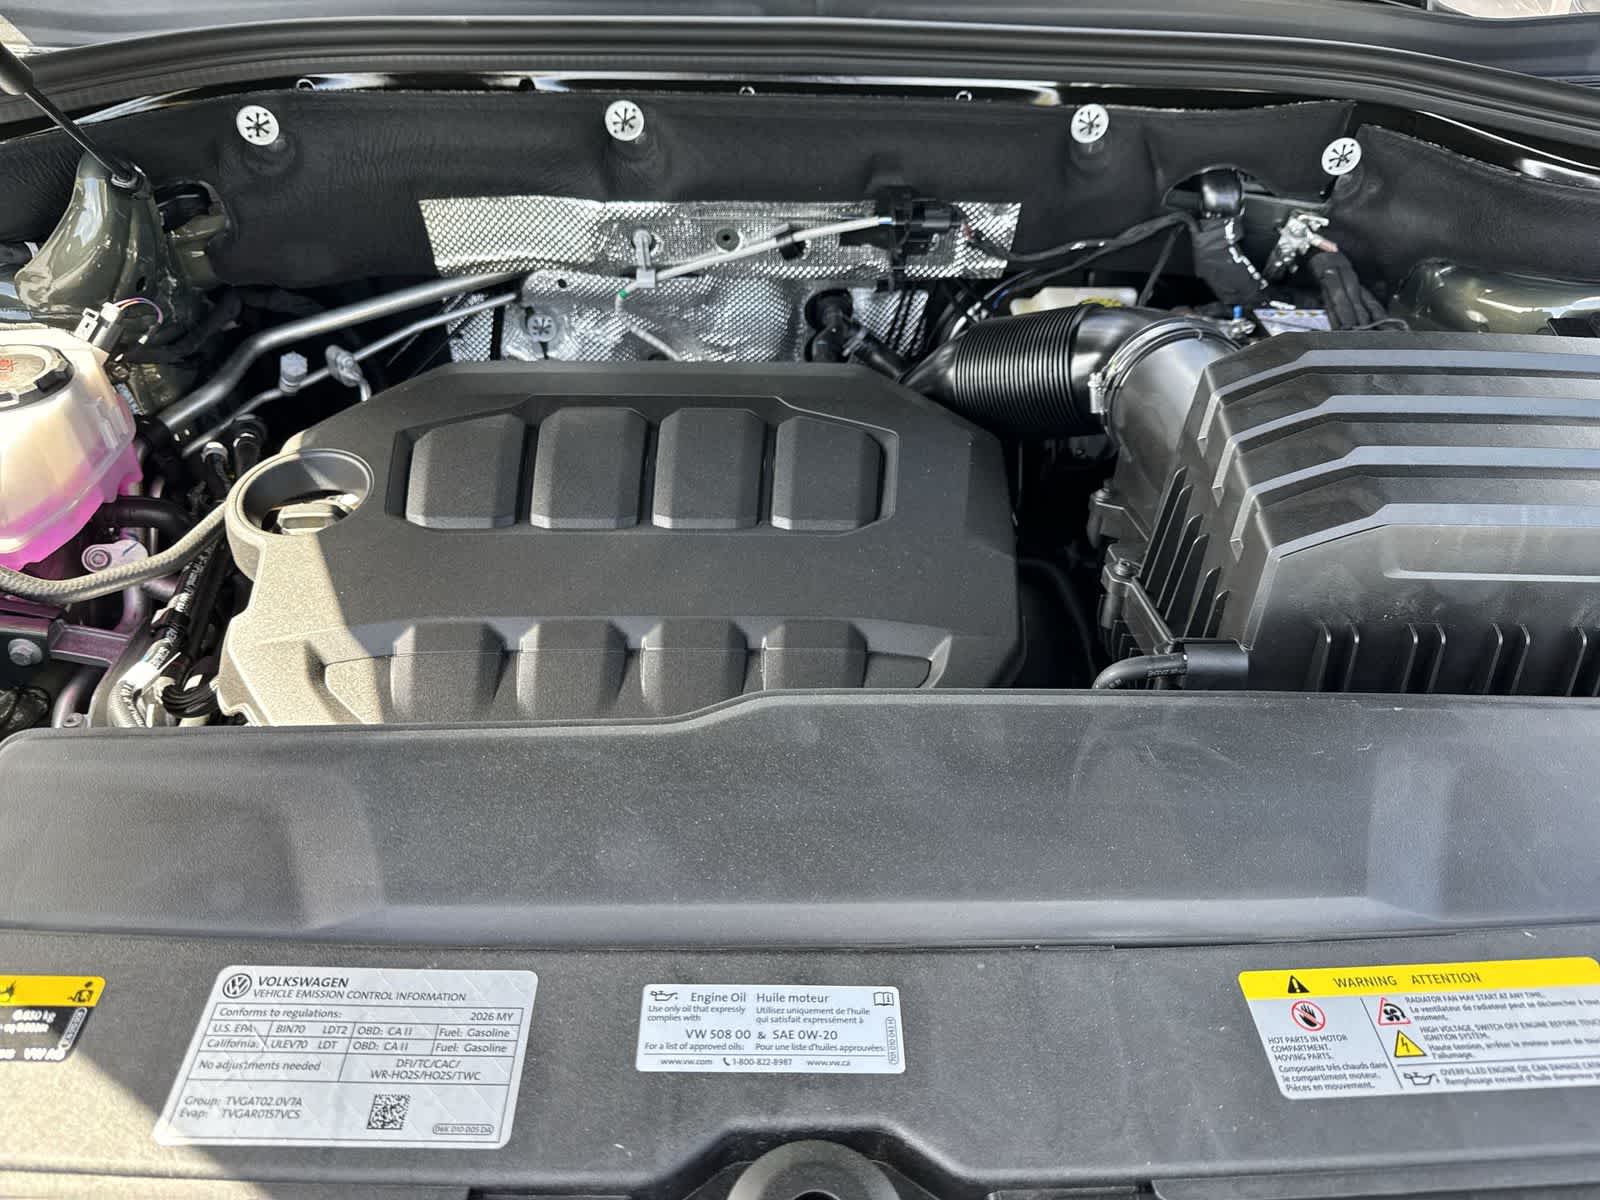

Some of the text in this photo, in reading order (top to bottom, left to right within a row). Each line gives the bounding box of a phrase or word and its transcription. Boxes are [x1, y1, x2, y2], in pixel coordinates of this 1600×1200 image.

[258, 976, 349, 988] VOLKSWAGEN
[1332, 972, 1482, 988] WARNING ATTENTION
[253, 989, 466, 1001] VEHICLE EMISSION CONTROL INFORMATION
[691, 992, 746, 1004] Engine Oil
[756, 992, 829, 1003] Huile moteur
[219, 1007, 342, 1019] Conforms to regulations:
[648, 1005, 745, 1015] Use only oil that expressly
[756, 1007, 785, 1015] Utilisez
[786, 1007, 834, 1017] uniquement
[835, 1007, 846, 1015] de
[470, 1012, 514, 1021] 2026 MY
[647, 1015, 681, 1023] complies
[756, 1016, 769, 1024] qui
[802, 1016, 857, 1025] expressément
[213, 1024, 232, 1033] U.S.
[276, 1025, 306, 1034] BIN70
[322, 1025, 348, 1035] LDT2
[357, 1026, 383, 1036] OBD:
[438, 1028, 463, 1037] Fuel:
[466, 1028, 511, 1038] Gasoline
[686, 1029, 838, 1040] VW 508 00 & SAE 0W-20
[1268, 1036, 1284, 1044] HOT
[1285, 1035, 1309, 1043] PARTS
[1319, 1034, 1348, 1042] MOTOR
[271, 1039, 309, 1049] ULEV70
[317, 1040, 338, 1049] LDT
[352, 1041, 379, 1051] OBD:
[435, 1042, 459, 1052] Fuel:
[463, 1043, 508, 1053] Gasoline
[644, 1042, 657, 1050] For
[666, 1042, 678, 1050] list
[679, 1042, 688, 1050] of
[689, 1042, 727, 1051] approved
[755, 1043, 774, 1051] Pour
[791, 1043, 807, 1051] liste
[1271, 1043, 1332, 1053] COMPARTMENT.
[660, 1058, 713, 1066] www.vw.com
[1274, 1053, 1307, 1061] MOVING
[198, 1060, 321, 1072] No adjustments needed
[396, 1059, 461, 1069] DFI/TC/CAC/
[1278, 1064, 1325, 1073] Composants
[1342, 1062, 1370, 1070] chauds
[1369, 1061, 1388, 1069] dans
[1291, 1073, 1348, 1082] compartiment
[184, 1096, 221, 1107] Group:
[179, 1109, 208, 1120] Evap:
